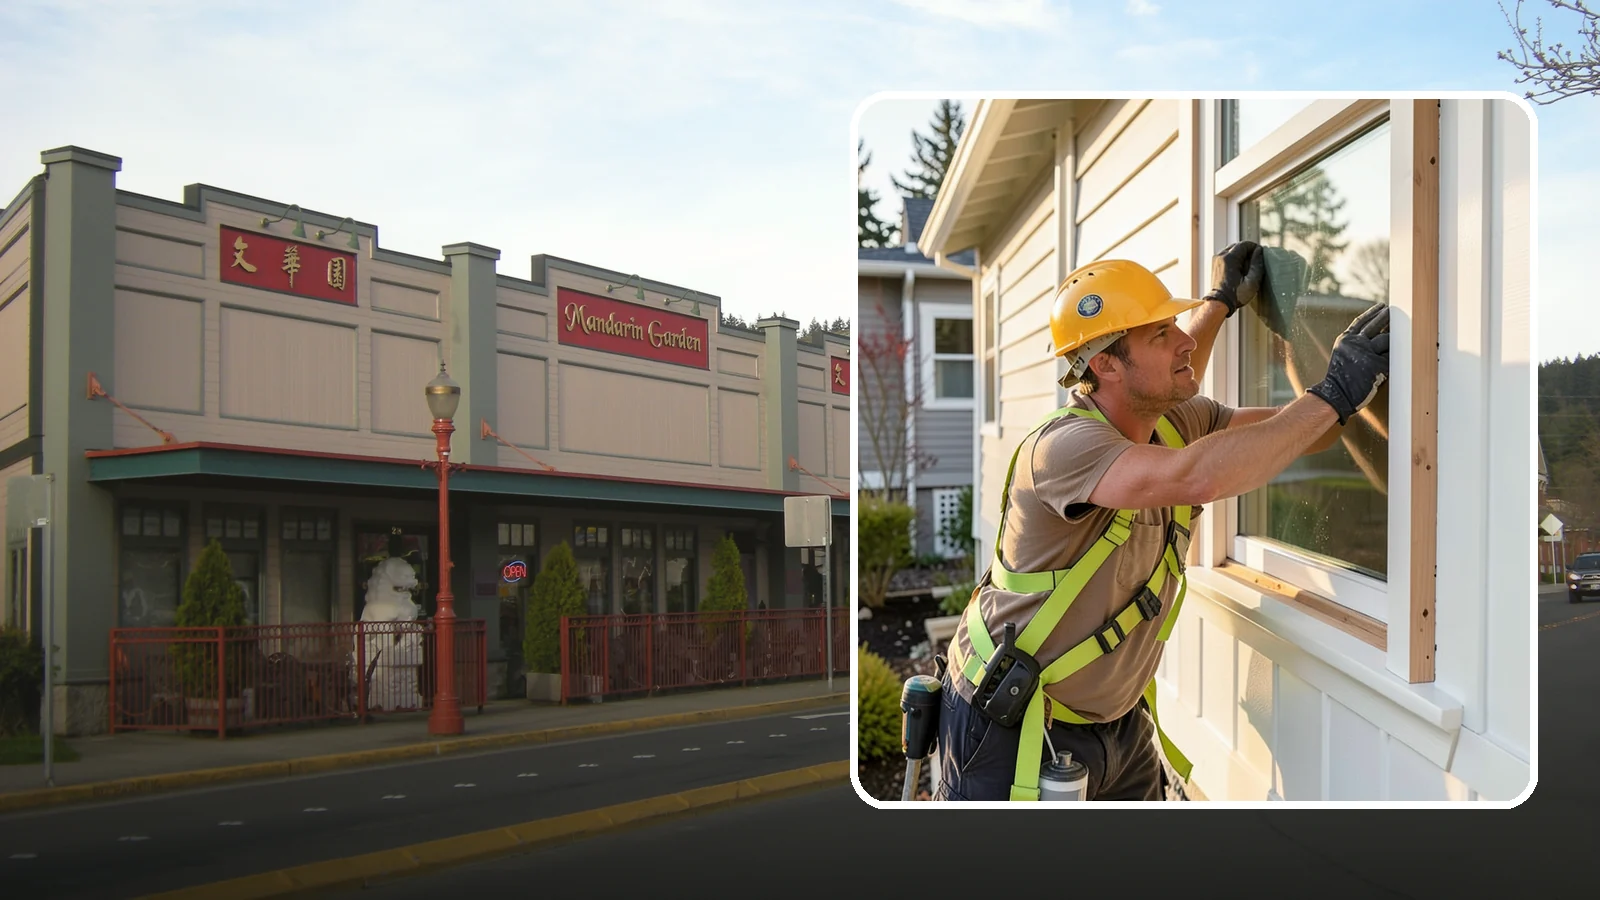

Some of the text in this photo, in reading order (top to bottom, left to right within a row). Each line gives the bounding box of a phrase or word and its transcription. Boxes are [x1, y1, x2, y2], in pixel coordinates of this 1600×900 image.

[565, 302, 701, 352] Mandarin Garden
[503, 565, 527, 578] OPEN
